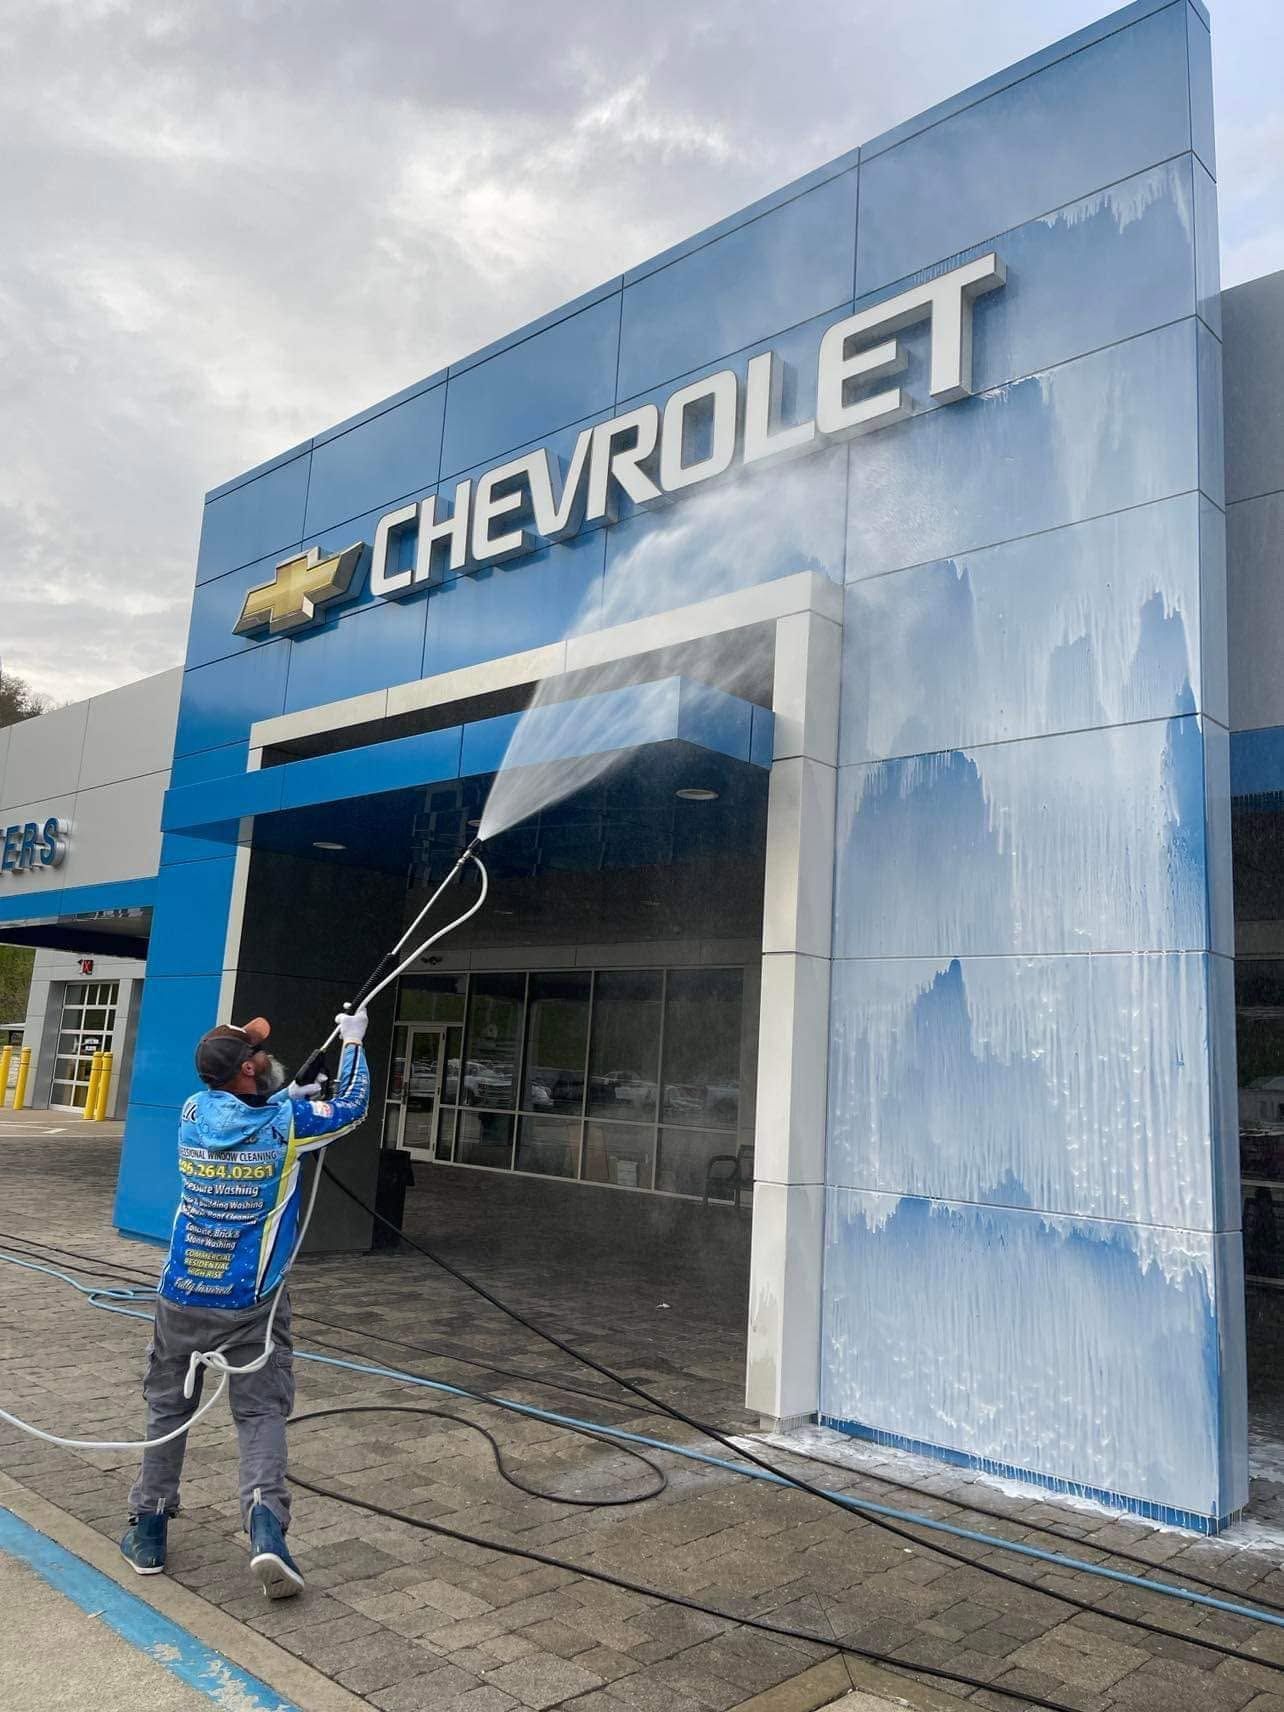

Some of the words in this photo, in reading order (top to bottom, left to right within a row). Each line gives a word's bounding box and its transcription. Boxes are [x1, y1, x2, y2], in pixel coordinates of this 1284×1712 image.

[371, 252, 1000, 597] CHEVROLET
[0, 817, 62, 873] ERS
[208, 1150, 238, 1161] WINDOW
[240, 1150, 278, 1161] CLEANING
[213, 1184, 259, 1198] Washing
[229, 1199, 264, 1210] Washing
[206, 1238, 236, 1250] Washing
